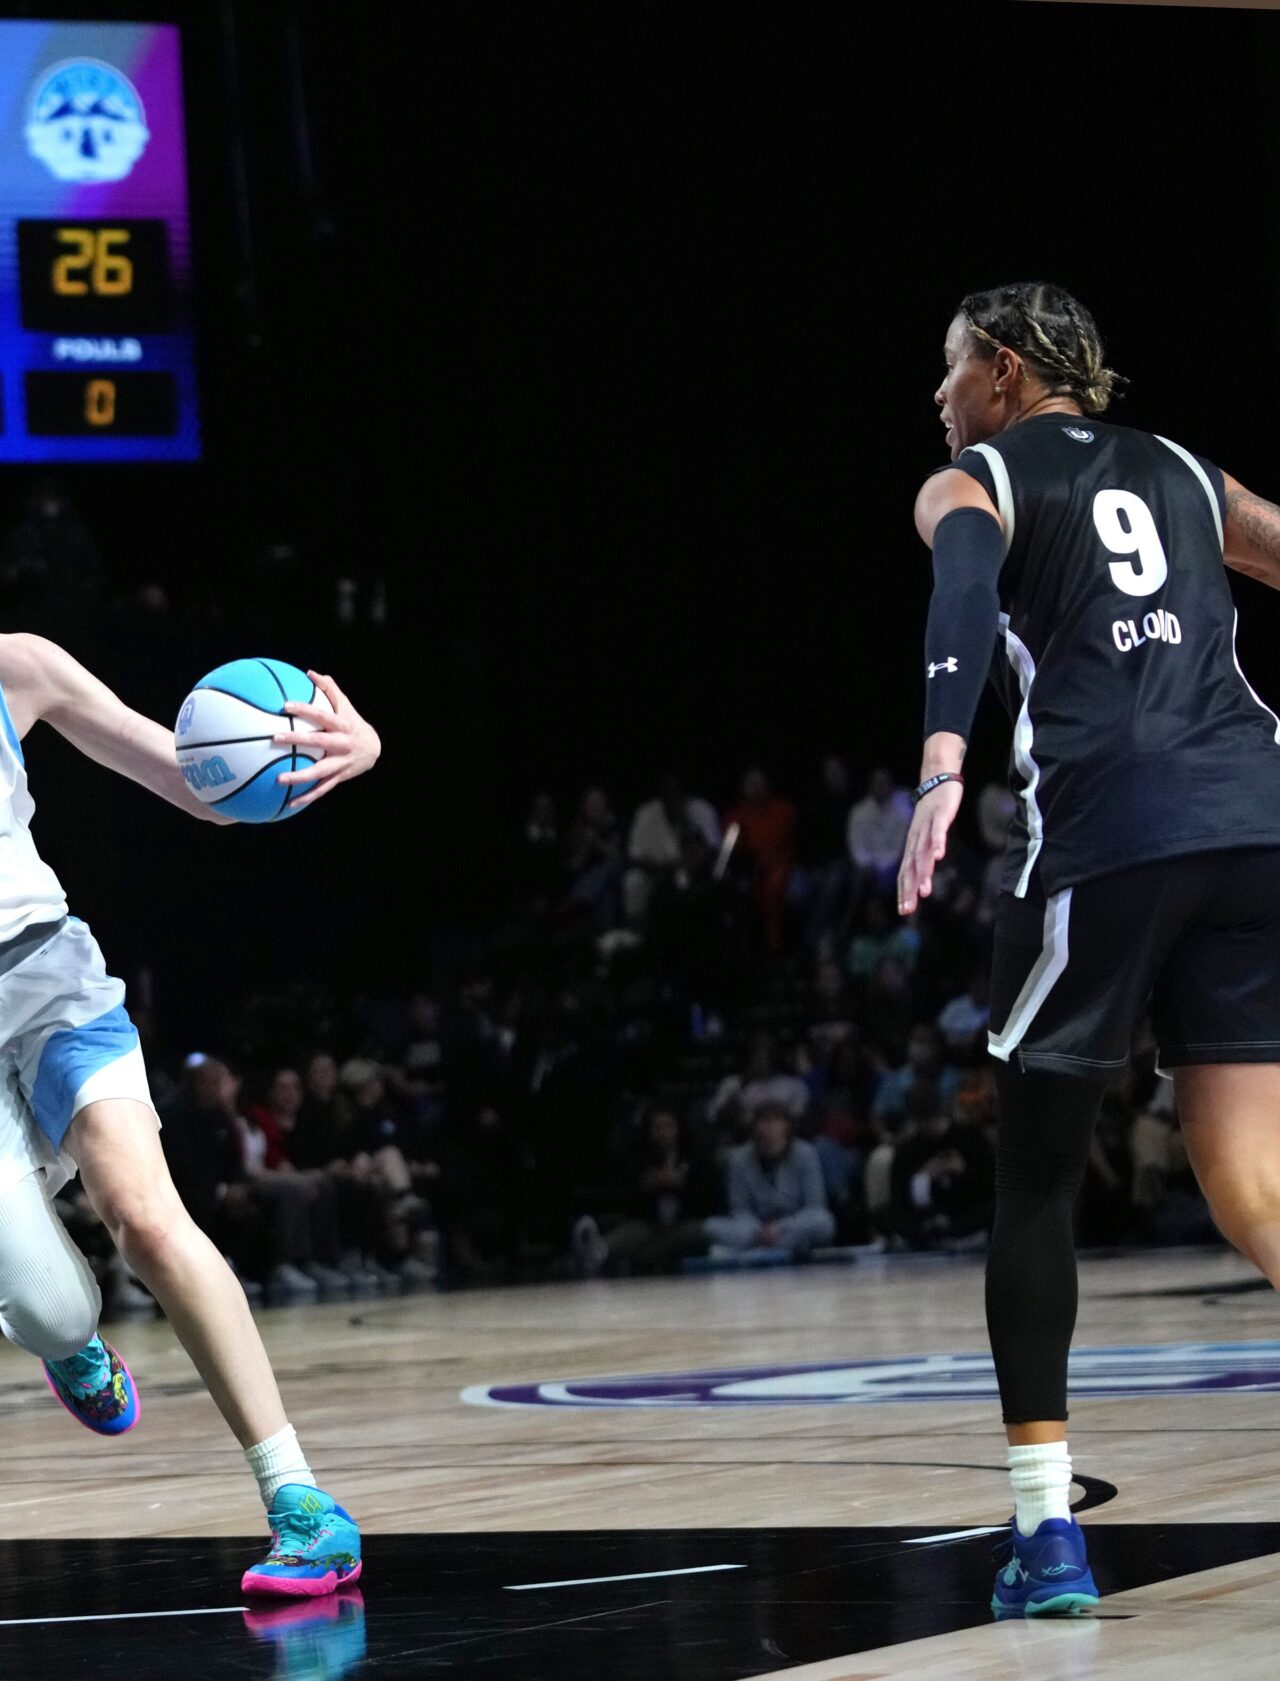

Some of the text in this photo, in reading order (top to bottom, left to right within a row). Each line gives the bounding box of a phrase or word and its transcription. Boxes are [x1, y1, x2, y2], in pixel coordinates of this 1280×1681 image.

[52, 229, 133, 296] 26
[52, 338, 142, 360] FOULS
[86, 379, 116, 426] 0
[1092, 488, 1168, 597] 9
